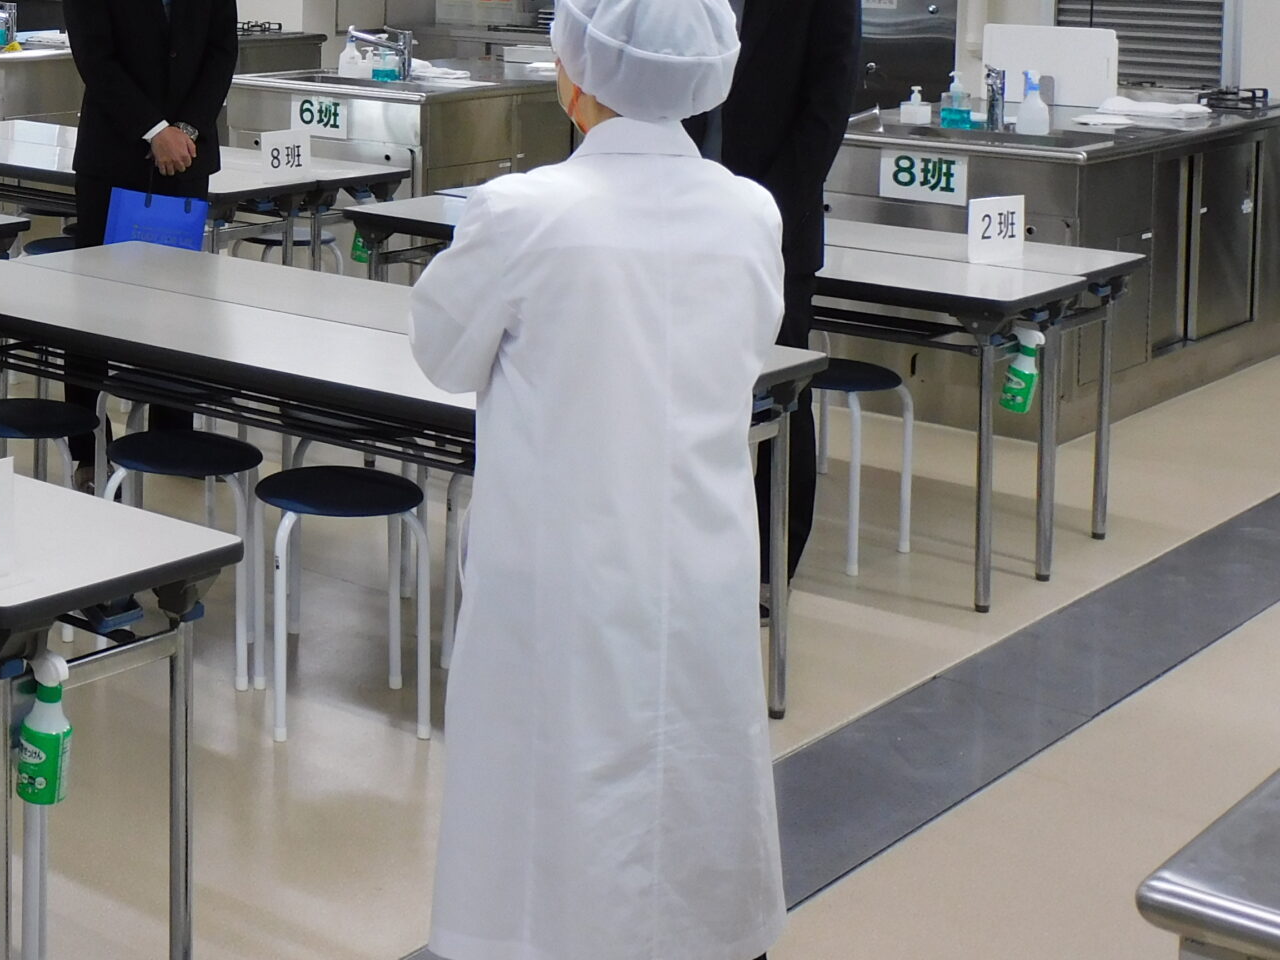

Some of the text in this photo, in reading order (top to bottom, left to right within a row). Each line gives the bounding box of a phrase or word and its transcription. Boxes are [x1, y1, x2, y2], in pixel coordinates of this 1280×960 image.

[299, 99, 340, 128] 6班
[270, 144, 302, 169] 8班
[892, 155, 956, 193] 8班
[981, 210, 1016, 240] 2班
